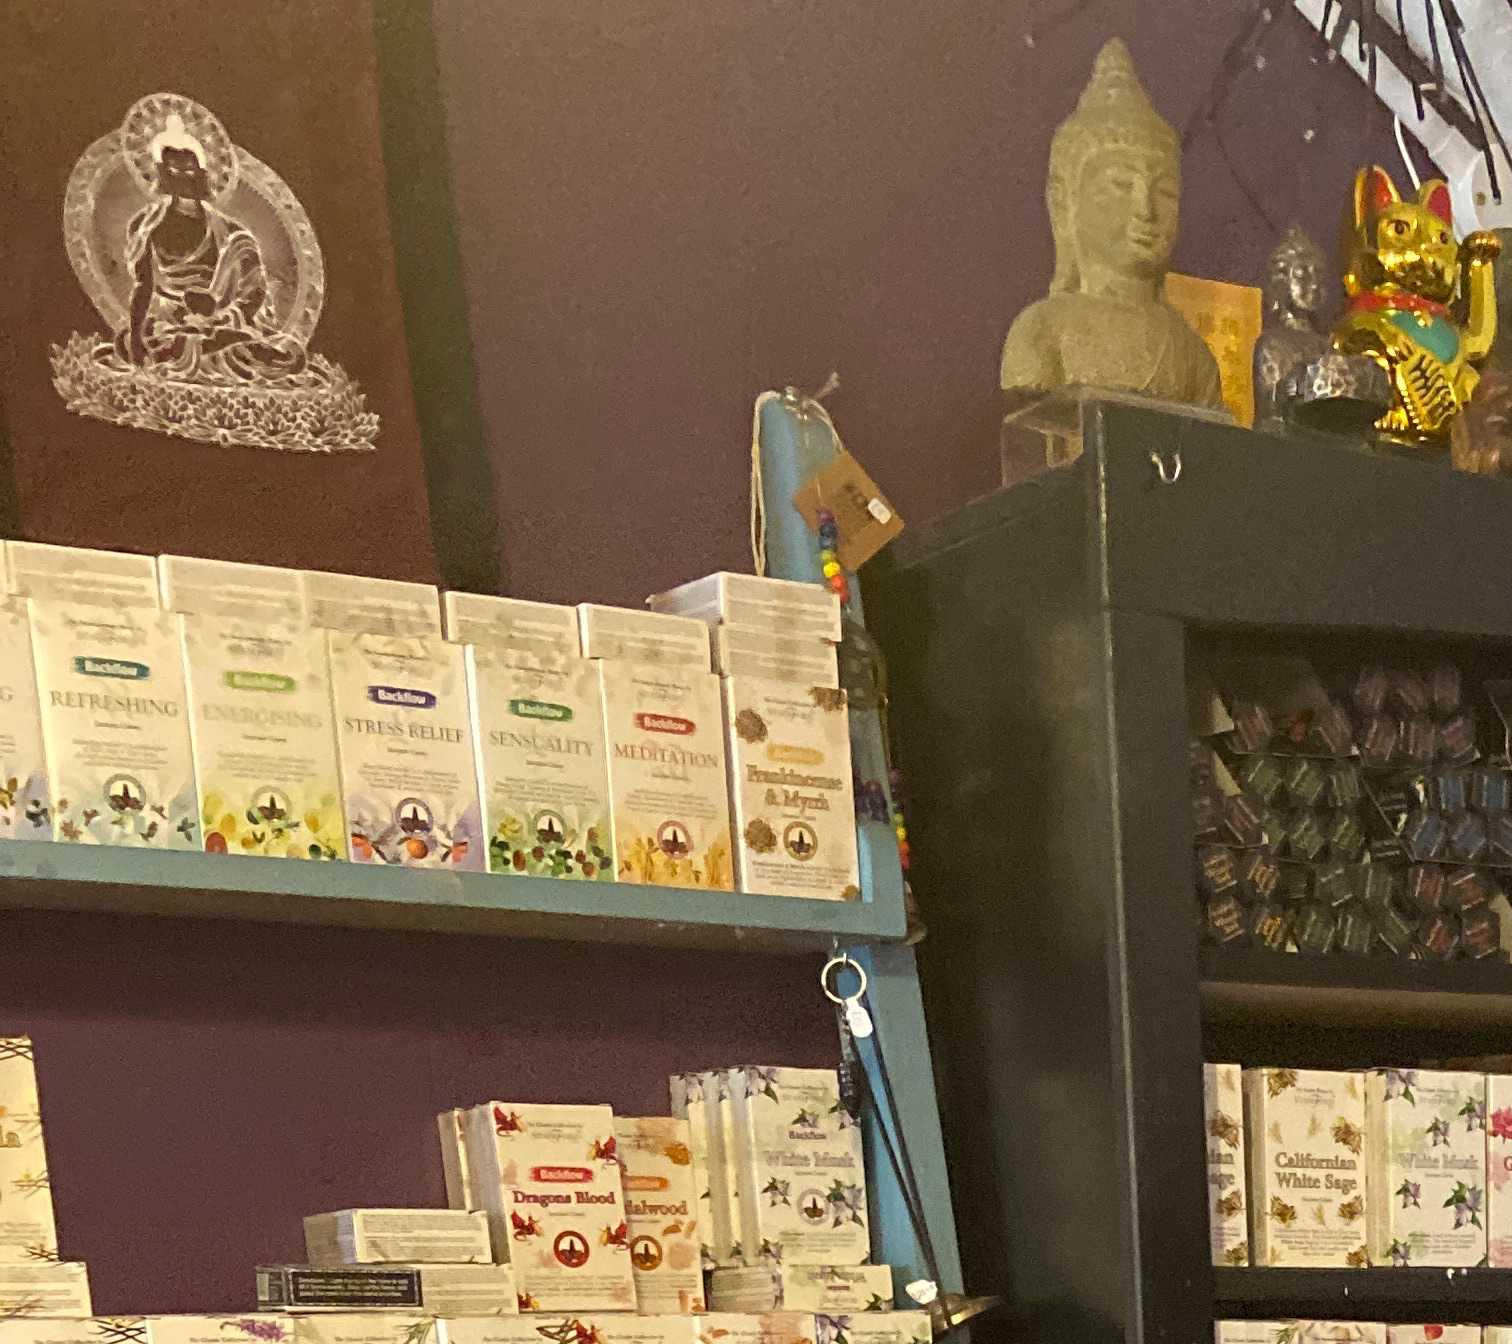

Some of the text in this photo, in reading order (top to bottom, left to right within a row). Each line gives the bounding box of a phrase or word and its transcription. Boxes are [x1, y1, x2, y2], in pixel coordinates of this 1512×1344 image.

[50, 690, 179, 717] REFRESHING
[345, 717, 465, 744] STRESS RELIEF
[488, 730, 595, 758] SENSUALITY
[613, 742, 719, 769] MEDITATION
[1275, 1152, 1357, 1171] Californian
[1275, 1172, 1357, 1192] White Sage
[514, 1190, 615, 1208] Dragons Blood
